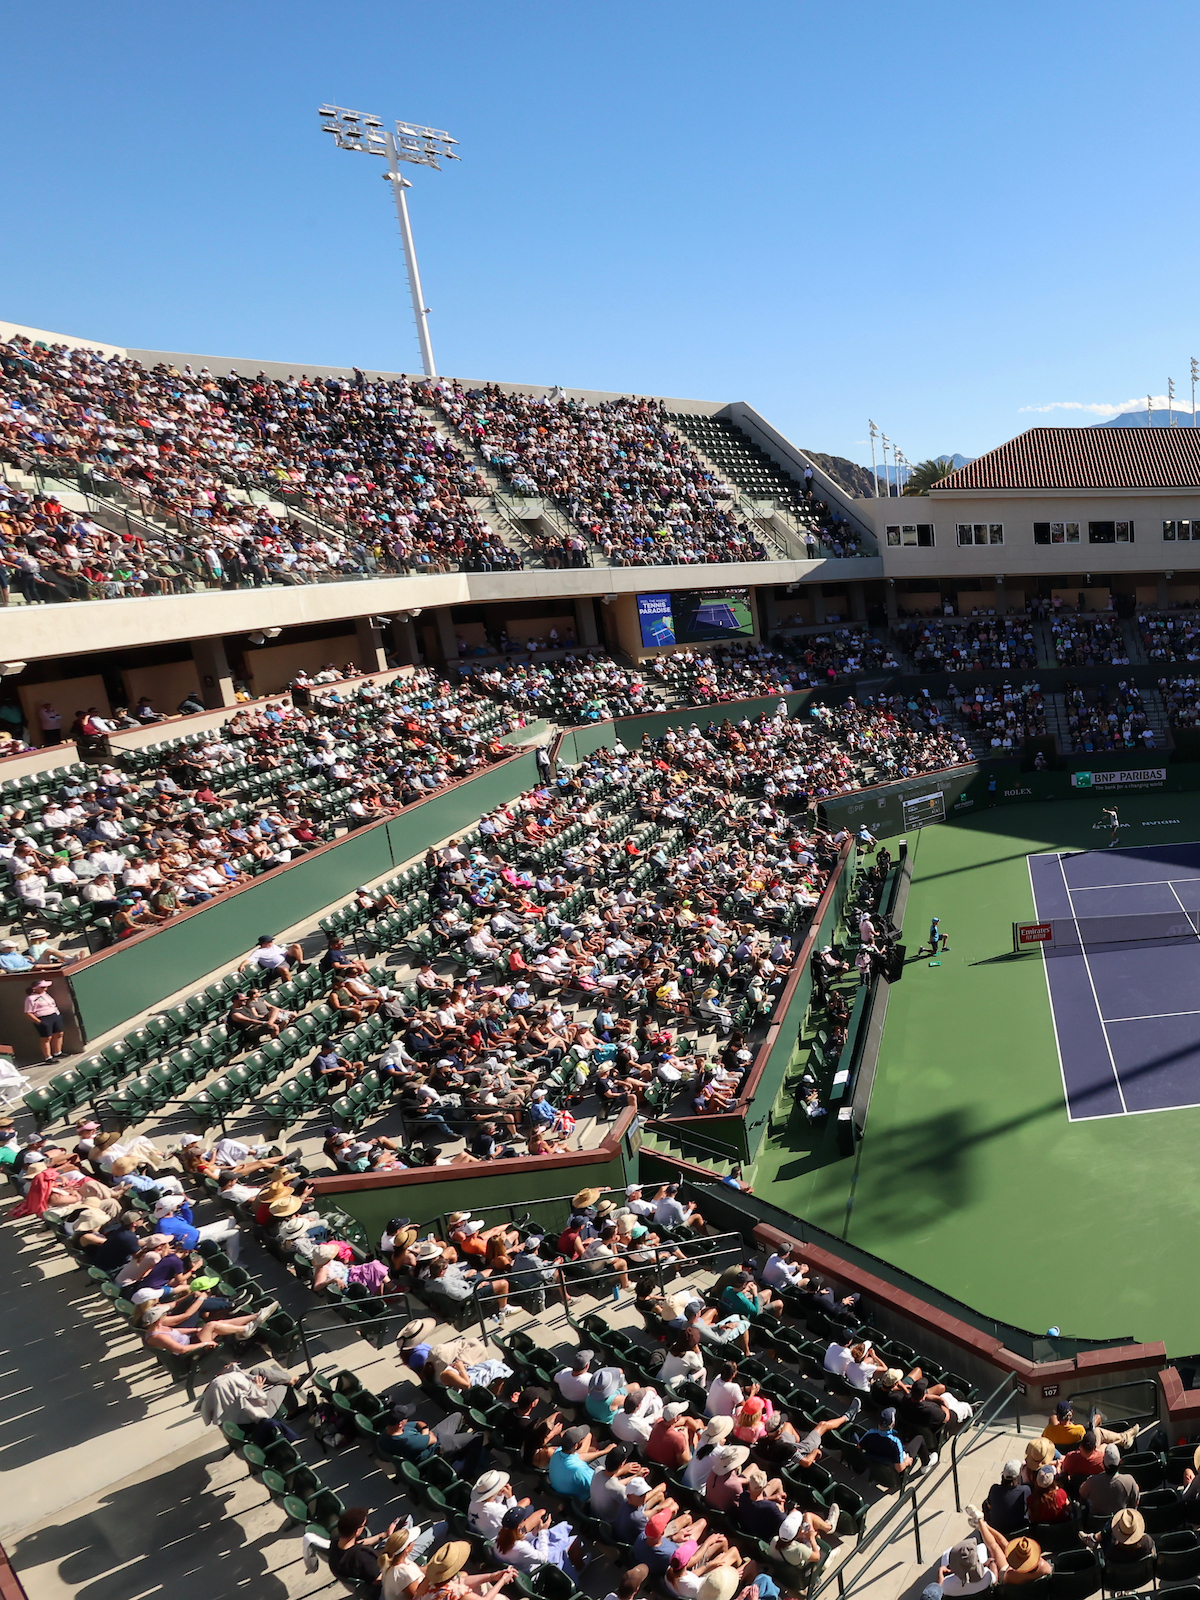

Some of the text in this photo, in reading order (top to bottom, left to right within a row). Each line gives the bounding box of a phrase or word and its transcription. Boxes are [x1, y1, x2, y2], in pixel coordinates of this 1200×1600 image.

[1095, 770, 1162, 783] BNP PARIBAS
[1004, 788, 1032, 796] ROLEX
[854, 804, 864, 812] PIF
